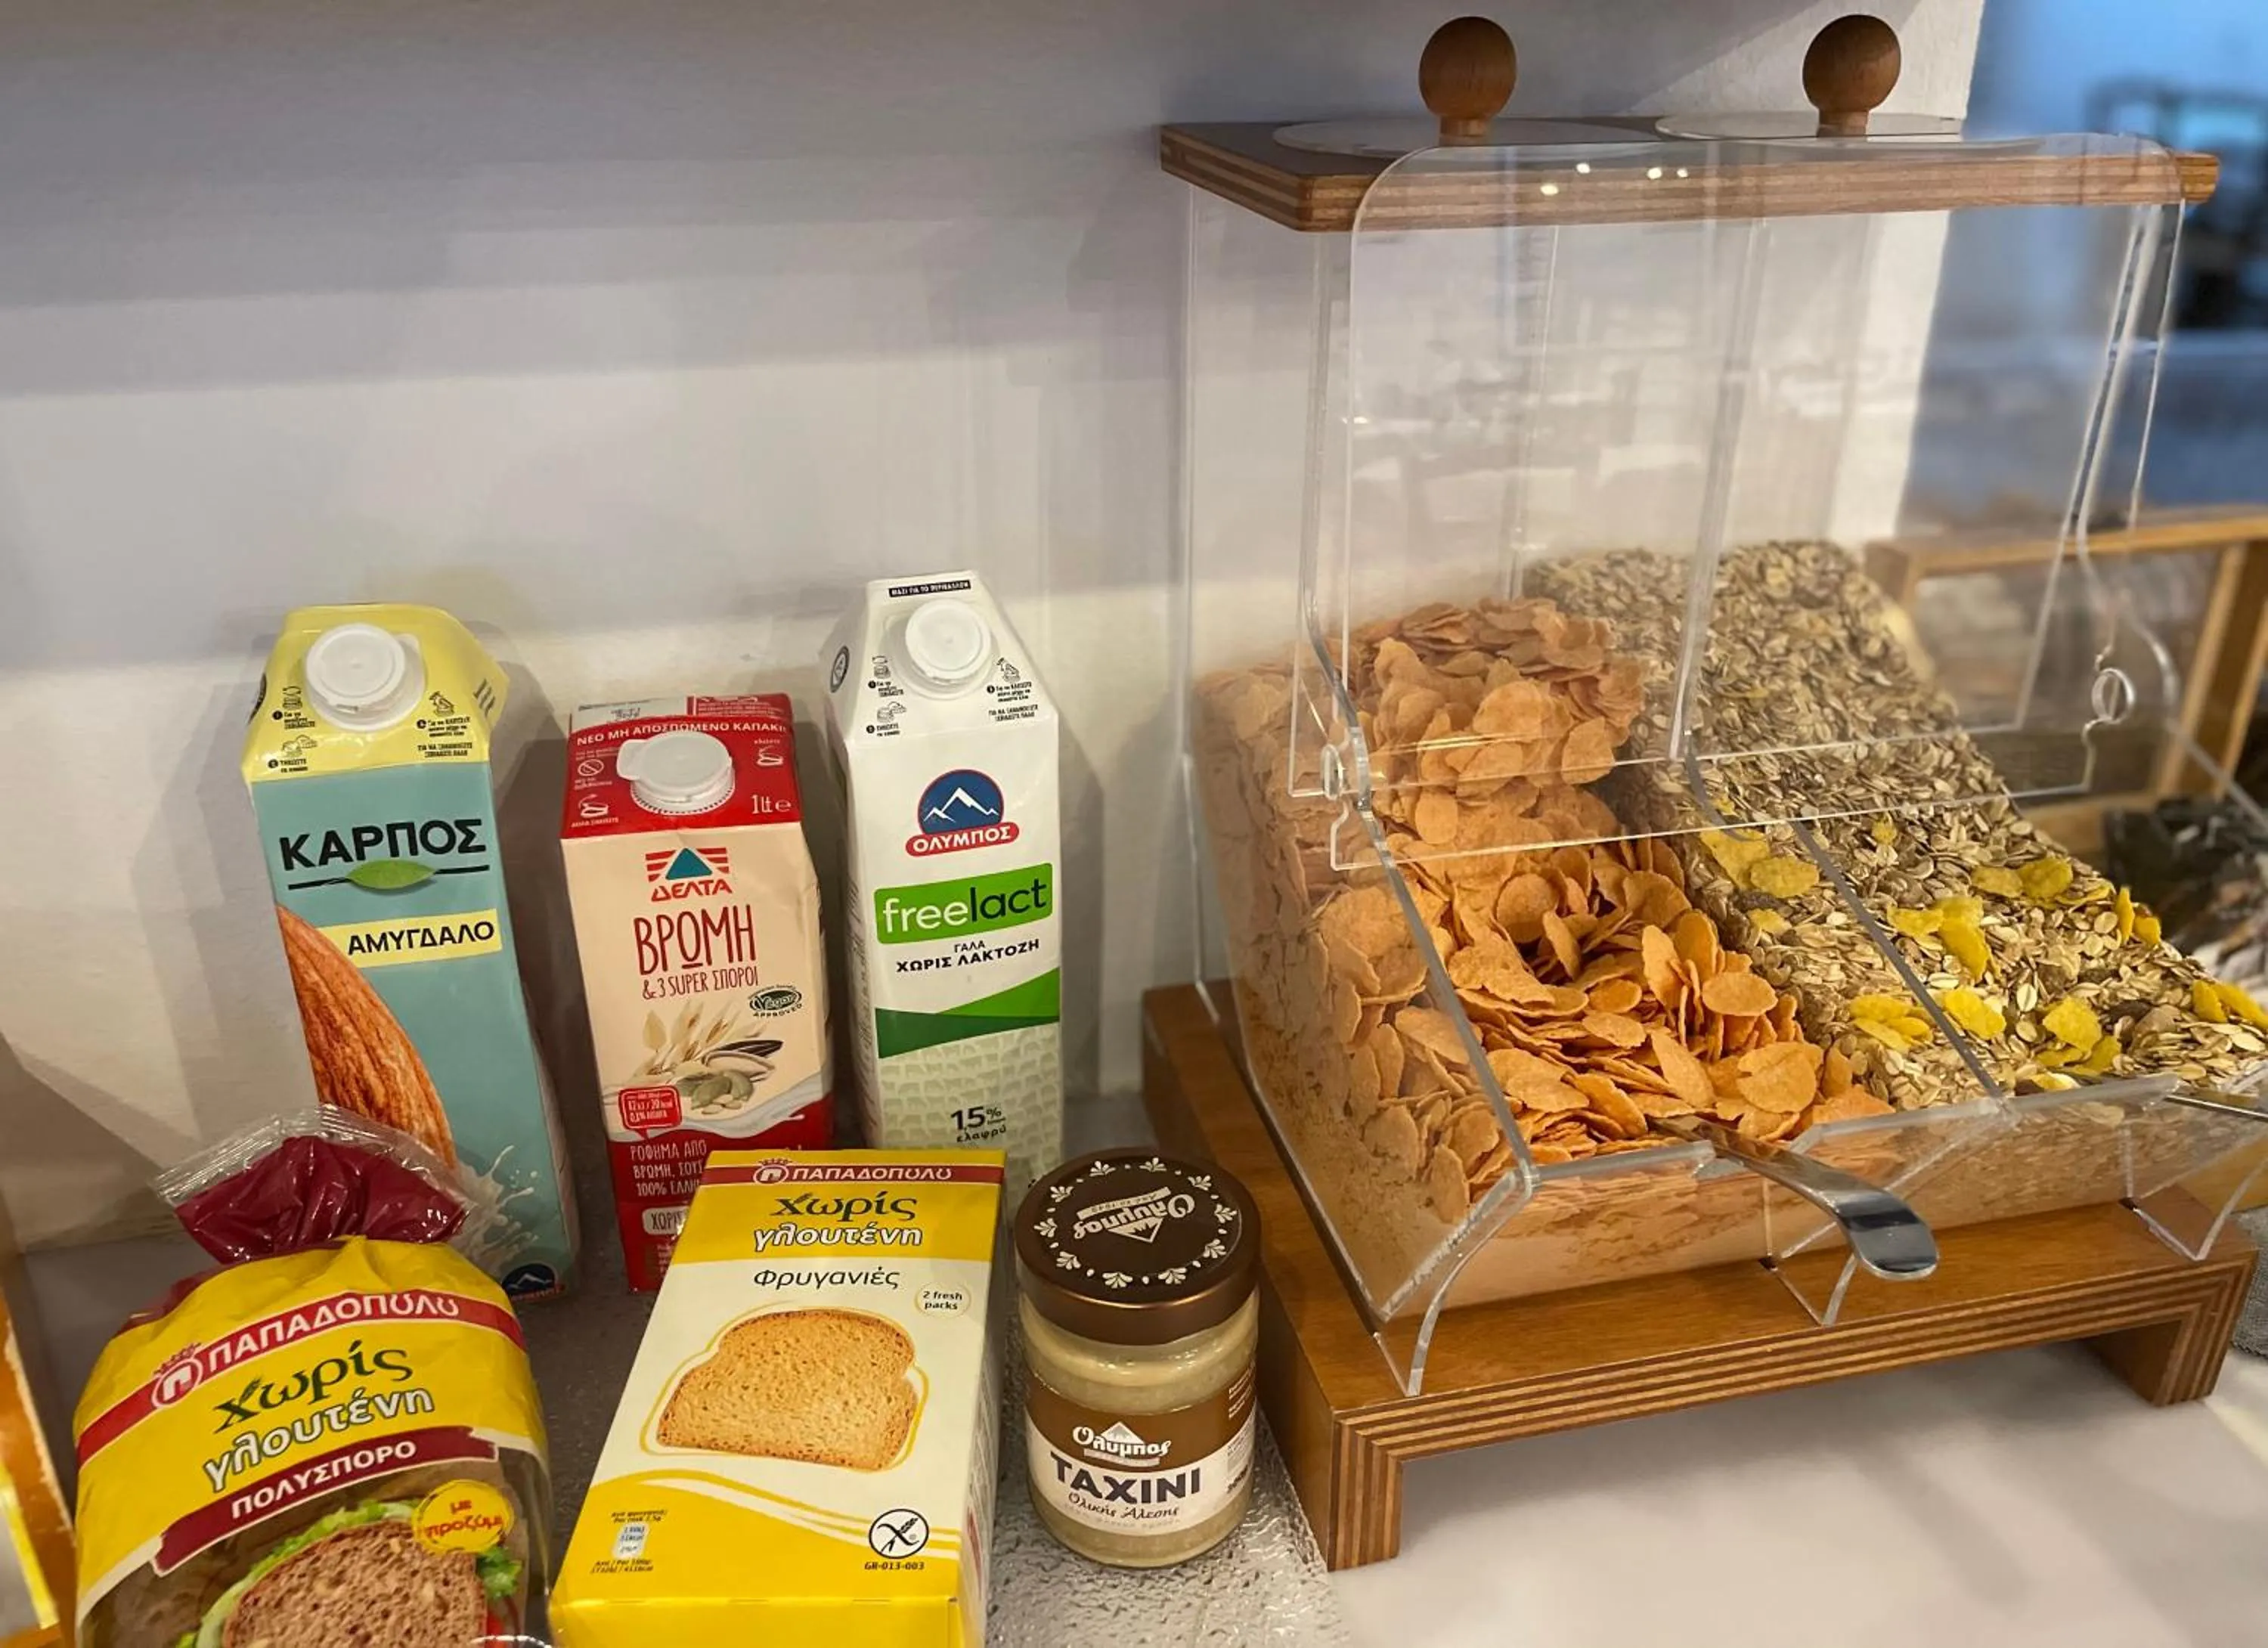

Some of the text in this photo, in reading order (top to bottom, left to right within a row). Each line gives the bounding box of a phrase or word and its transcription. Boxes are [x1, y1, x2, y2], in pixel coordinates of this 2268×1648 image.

[577, 733, 605, 746] ΝΕΟ
[608, 728, 630, 740] ΜΗ
[279, 819, 486, 871] ΚΑΡΠΟΣ
[912, 826, 1012, 853] ΟΛΥΜΠΟΣ
[651, 878, 733, 902] ΔΕΛΤΑ
[882, 878, 1047, 934] freelact
[348, 921, 494, 956] ΑΜΥΓΔΑΛΟ
[634, 904, 757, 975] ΒΡΩΜΗ
[954, 940, 986, 953] ΓΑΛΑ
[897, 939, 1040, 973] ΧΩΡΙΣ ΛΑΚΤΟΖΗ
[643, 965, 759, 999] & 3 SUPER ΣΠΟΡΟΙ
[630, 1139, 708, 1161] ΡΟΦΗΜΑ ΑΠΟ
[636, 1182, 668, 1197] 100%
[754, 1222, 922, 1252] γλουτένη
[753, 1266, 901, 1290] Φρυγανιές
[923, 1290, 962, 1300] 2 fresh
[925, 1301, 958, 1310] packs
[203, 1386, 435, 1493] γλουτένη
[231, 1440, 417, 1519] ΠΟΛΥΣΠΟΡΟ
[1050, 1451, 1201, 1504] ΤΑΧΙΝΙ
[450, 1500, 472, 1515] με
[1068, 1492, 1117, 1517] Ολικής
[863, 1560, 925, 1571] GR-013-003
